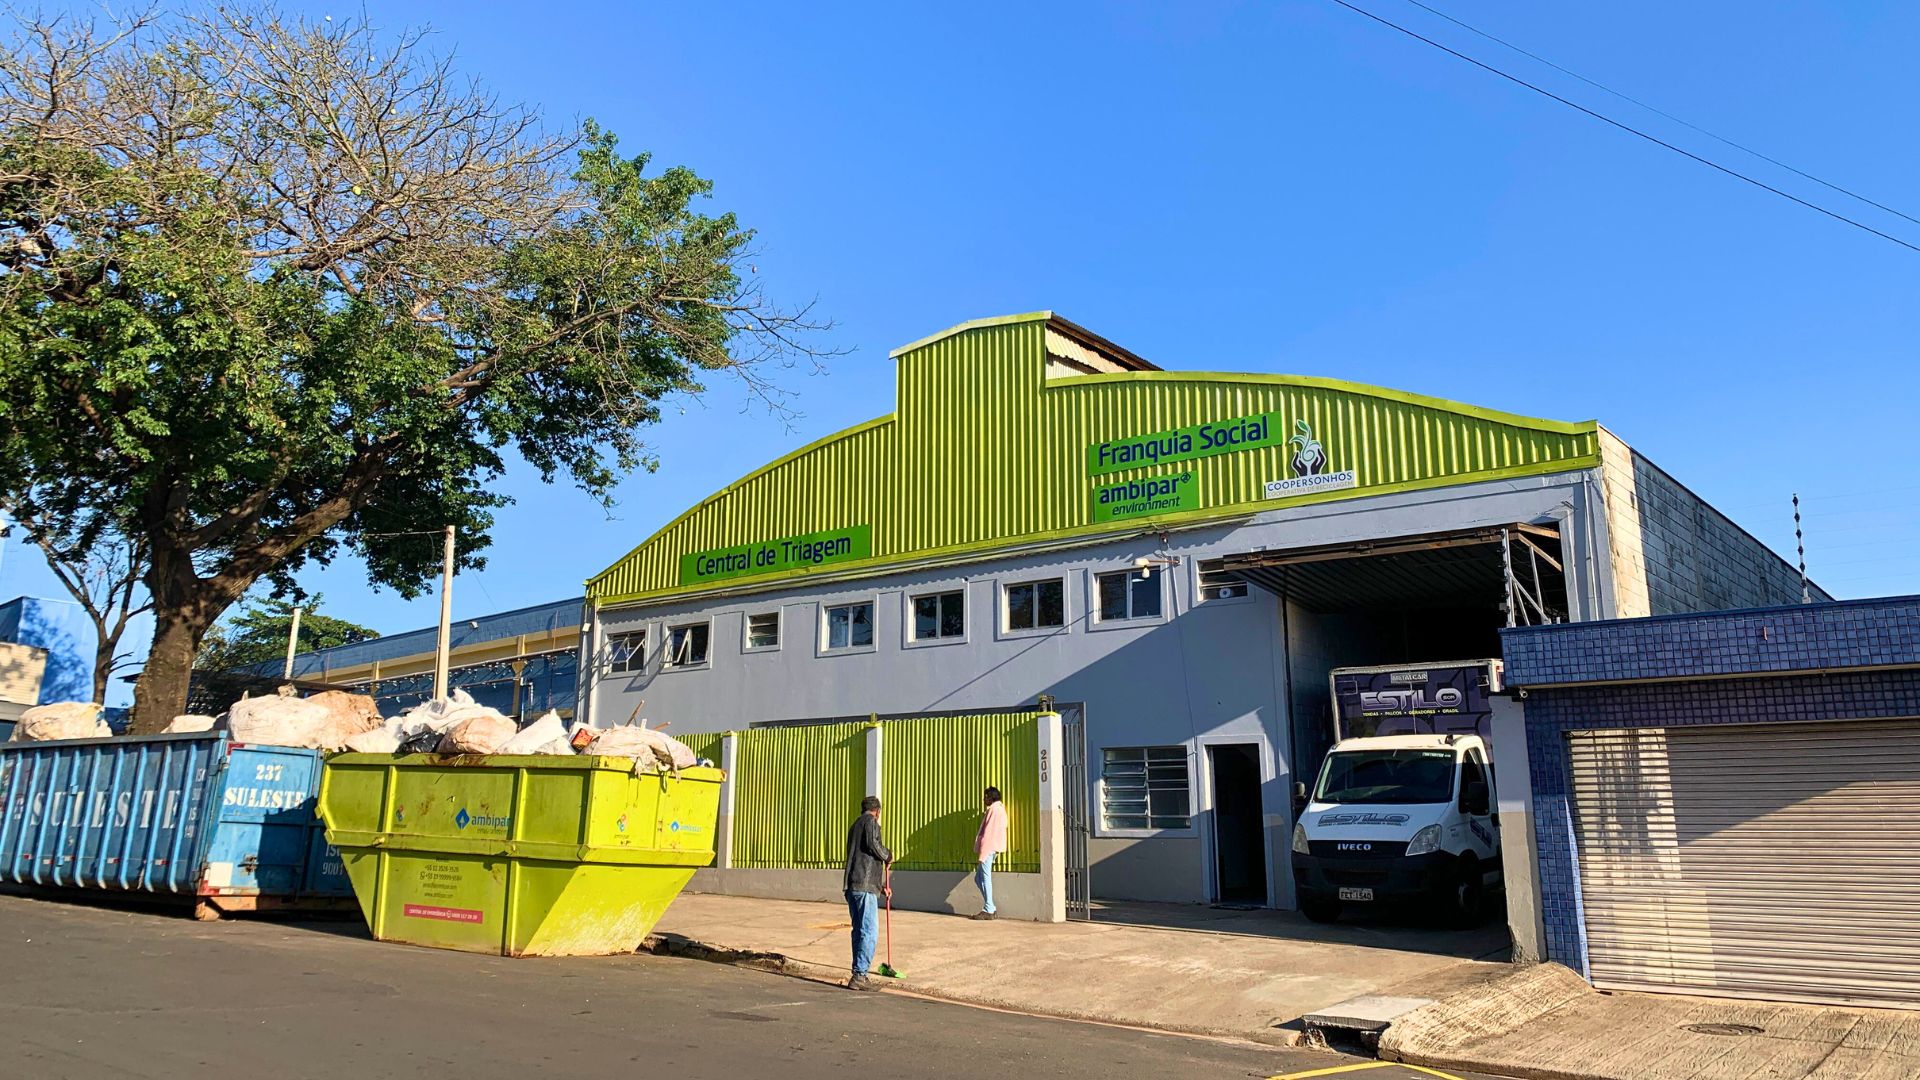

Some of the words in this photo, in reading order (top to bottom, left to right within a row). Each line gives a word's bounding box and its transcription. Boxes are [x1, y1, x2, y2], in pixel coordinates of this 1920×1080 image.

[1099, 431, 1192, 467] Franquia
[1199, 416, 1268, 449] Social
[1100, 477, 1180, 504] ambipar
[1267, 472, 1353, 491] COOPERSONHOS
[1112, 496, 1181, 515] environment
[697, 548, 751, 577] Central
[756, 547, 776, 567] de
[781, 537, 851, 564] Triagem
[1360, 688, 1463, 711] ESTILO
[255, 764, 283, 782] 237
[30, 790, 181, 829] SULESTE
[223, 786, 307, 810] SULESTE
[471, 815, 511, 829] ambipar
[1337, 843, 1372, 851] IVECO
